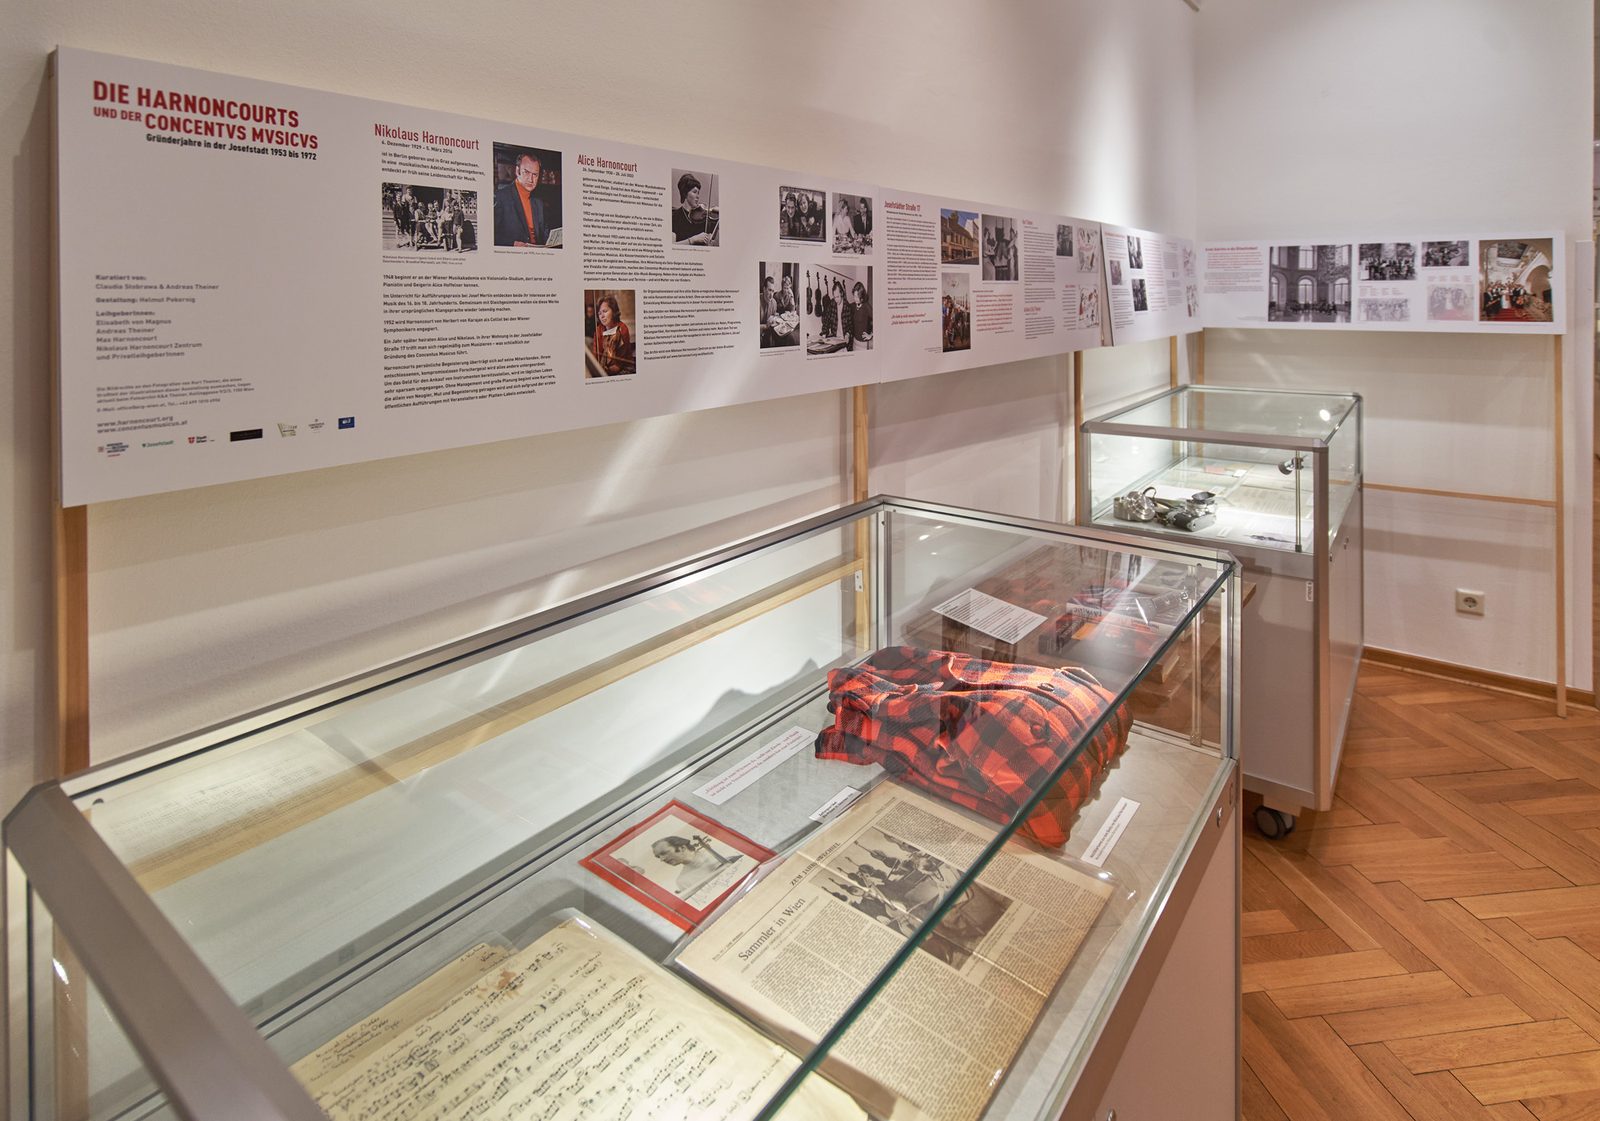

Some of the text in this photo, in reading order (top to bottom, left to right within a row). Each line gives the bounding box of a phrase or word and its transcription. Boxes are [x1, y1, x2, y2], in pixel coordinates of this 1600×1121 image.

[93, 80, 299, 128] DIE HARNONCOURTS
[93, 106, 318, 149] UND DER CONCENTVS MVSICVS
[375, 124, 479, 150] Nikolaus Harnoncourt
[146, 133, 317, 160] Gründerjahre in der Josefstadt 1953 bis 1972
[578, 154, 637, 172] Alice Harnoncourt
[738, 926, 776, 961] Sammler
[774, 918, 786, 927] in
[782, 898, 806, 916] Wien
